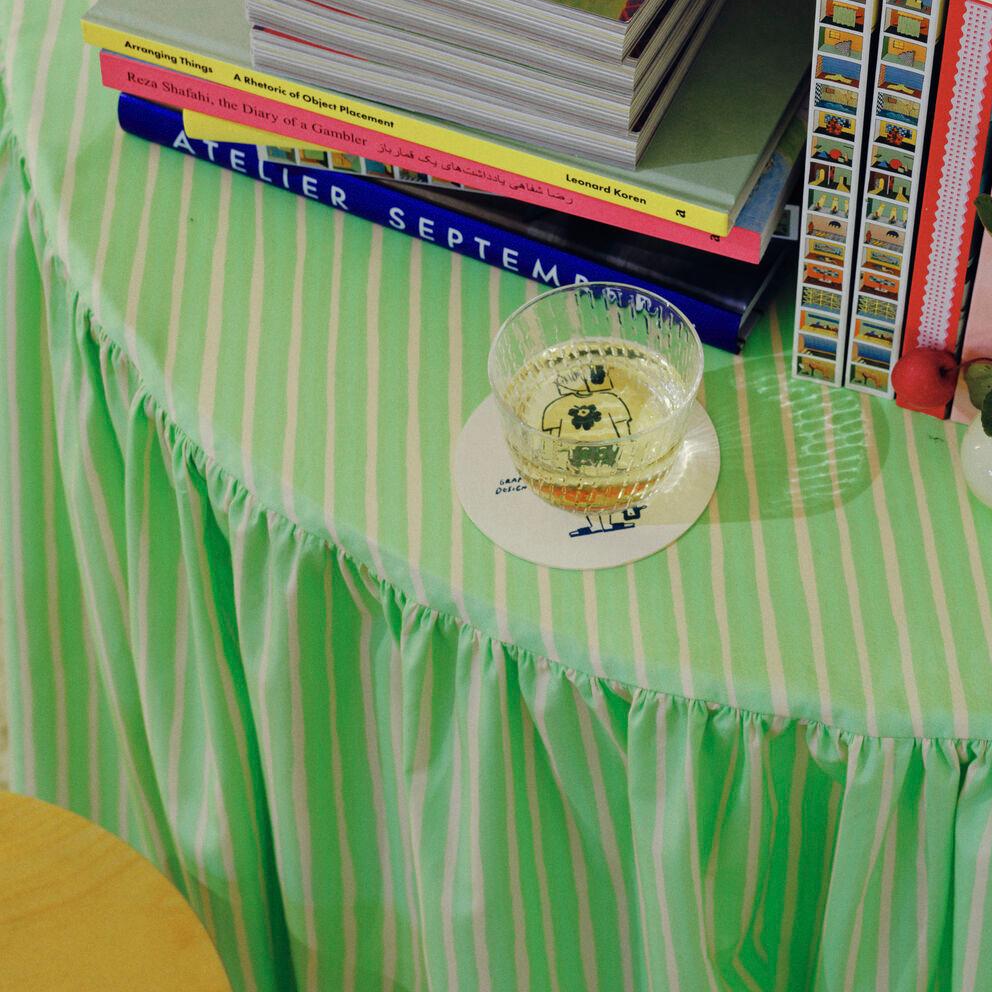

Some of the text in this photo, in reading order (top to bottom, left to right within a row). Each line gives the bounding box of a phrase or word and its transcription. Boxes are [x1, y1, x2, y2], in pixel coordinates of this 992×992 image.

[124, 40, 214, 74] Arranging Things
[127, 71, 368, 146] Reza Shafahi, the Diary of a Gambler
[233, 73, 394, 128] A Rhetoric of Object Placement
[173, 130, 348, 210] ATELIER
[547, 188, 574, 205] رضا
[566, 173, 647, 205] Leonard Koren
[675, 209, 686, 219] a
